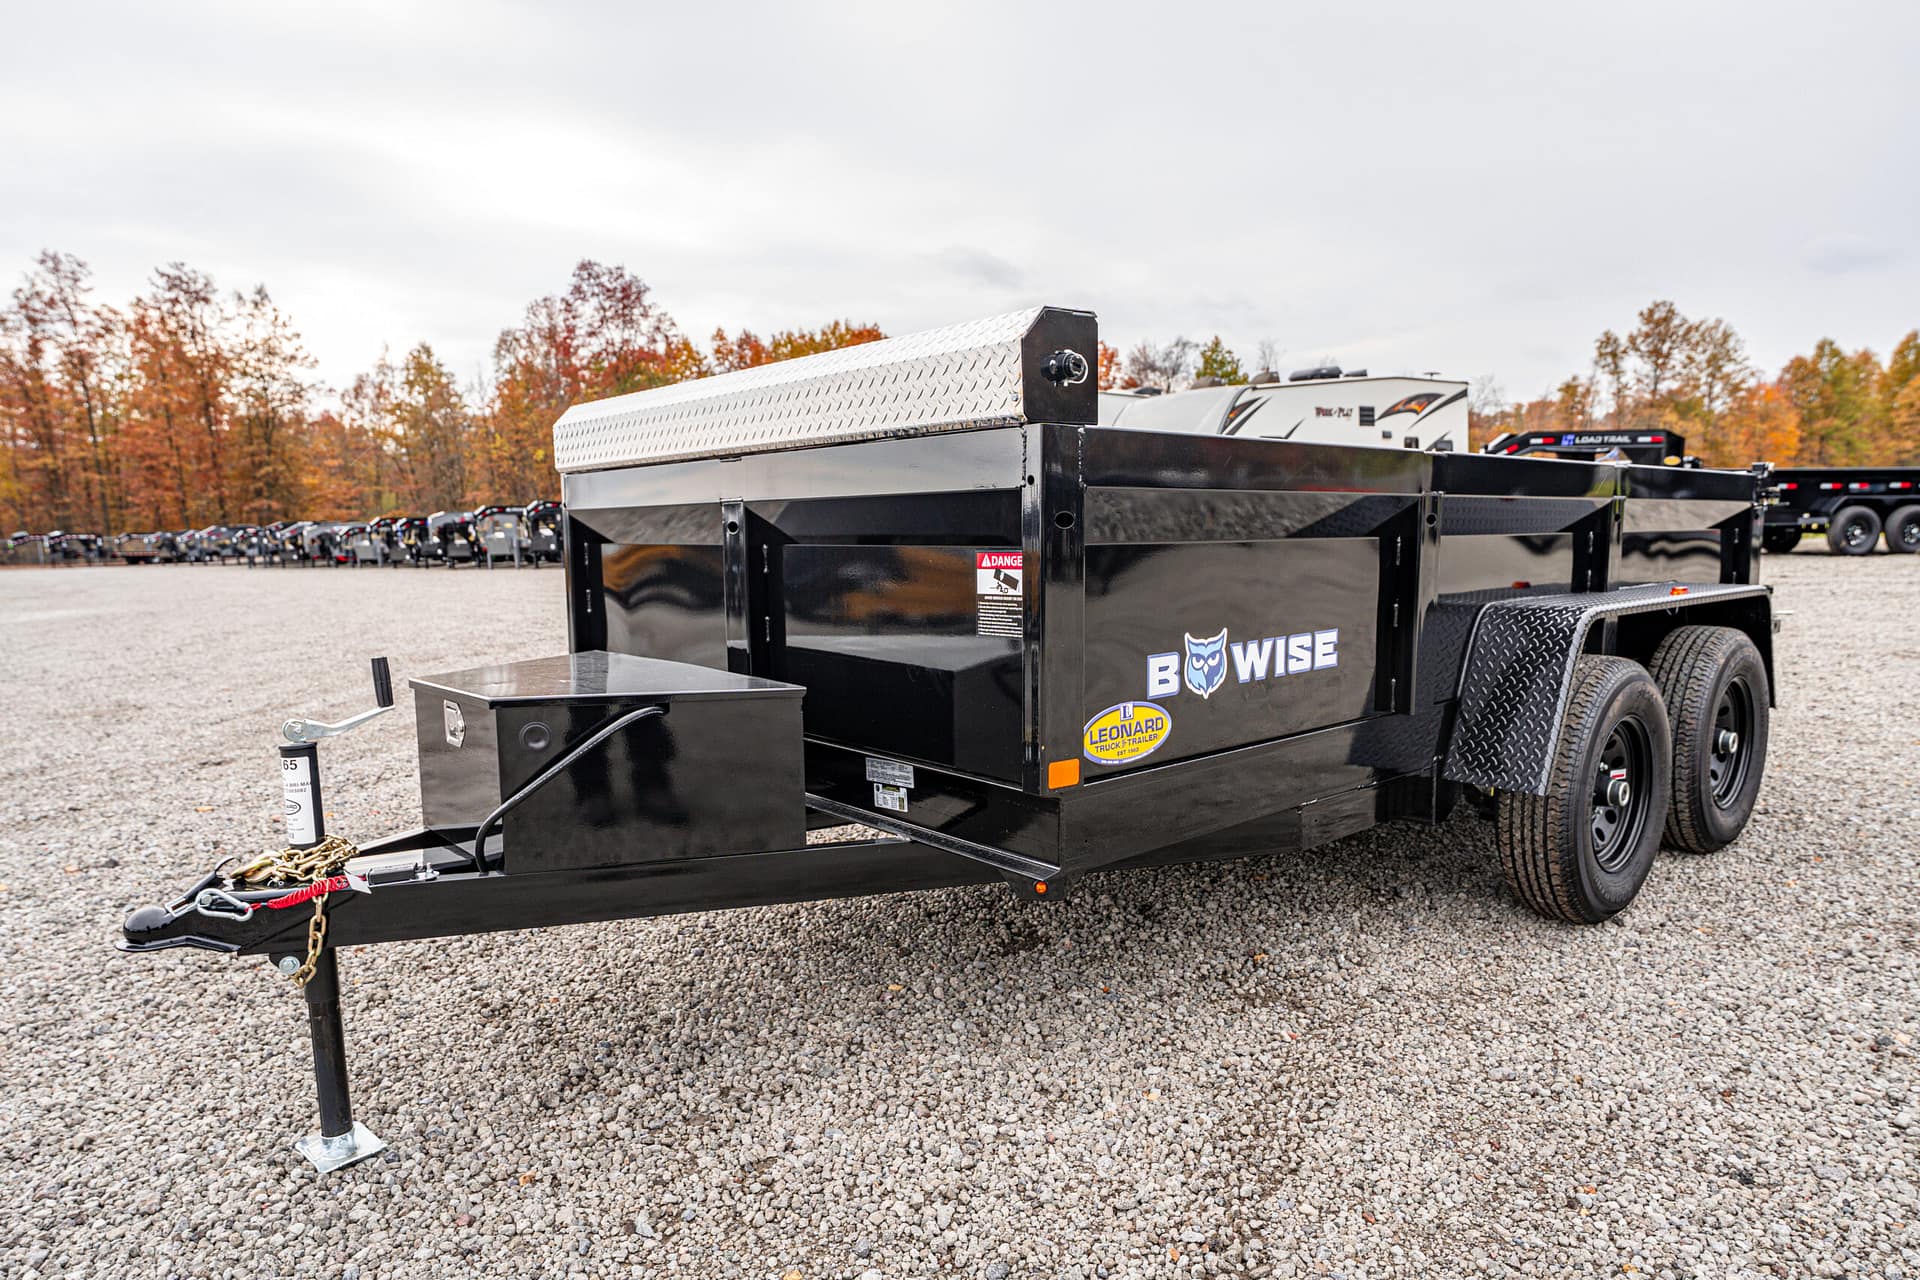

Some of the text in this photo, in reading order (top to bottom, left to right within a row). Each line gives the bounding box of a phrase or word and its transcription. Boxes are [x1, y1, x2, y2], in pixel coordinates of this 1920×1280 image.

[1575, 435, 1602, 444] LOAD
[1603, 434, 1632, 444] TRAIL
[991, 555, 1023, 567] DANGE
[1230, 628, 1339, 684] WISE
[1089, 716, 1164, 745] LEONARD
[1094, 741, 1121, 753] TRUCK
[1126, 733, 1158, 747] TRAILER
[283, 759, 298, 771] 65
